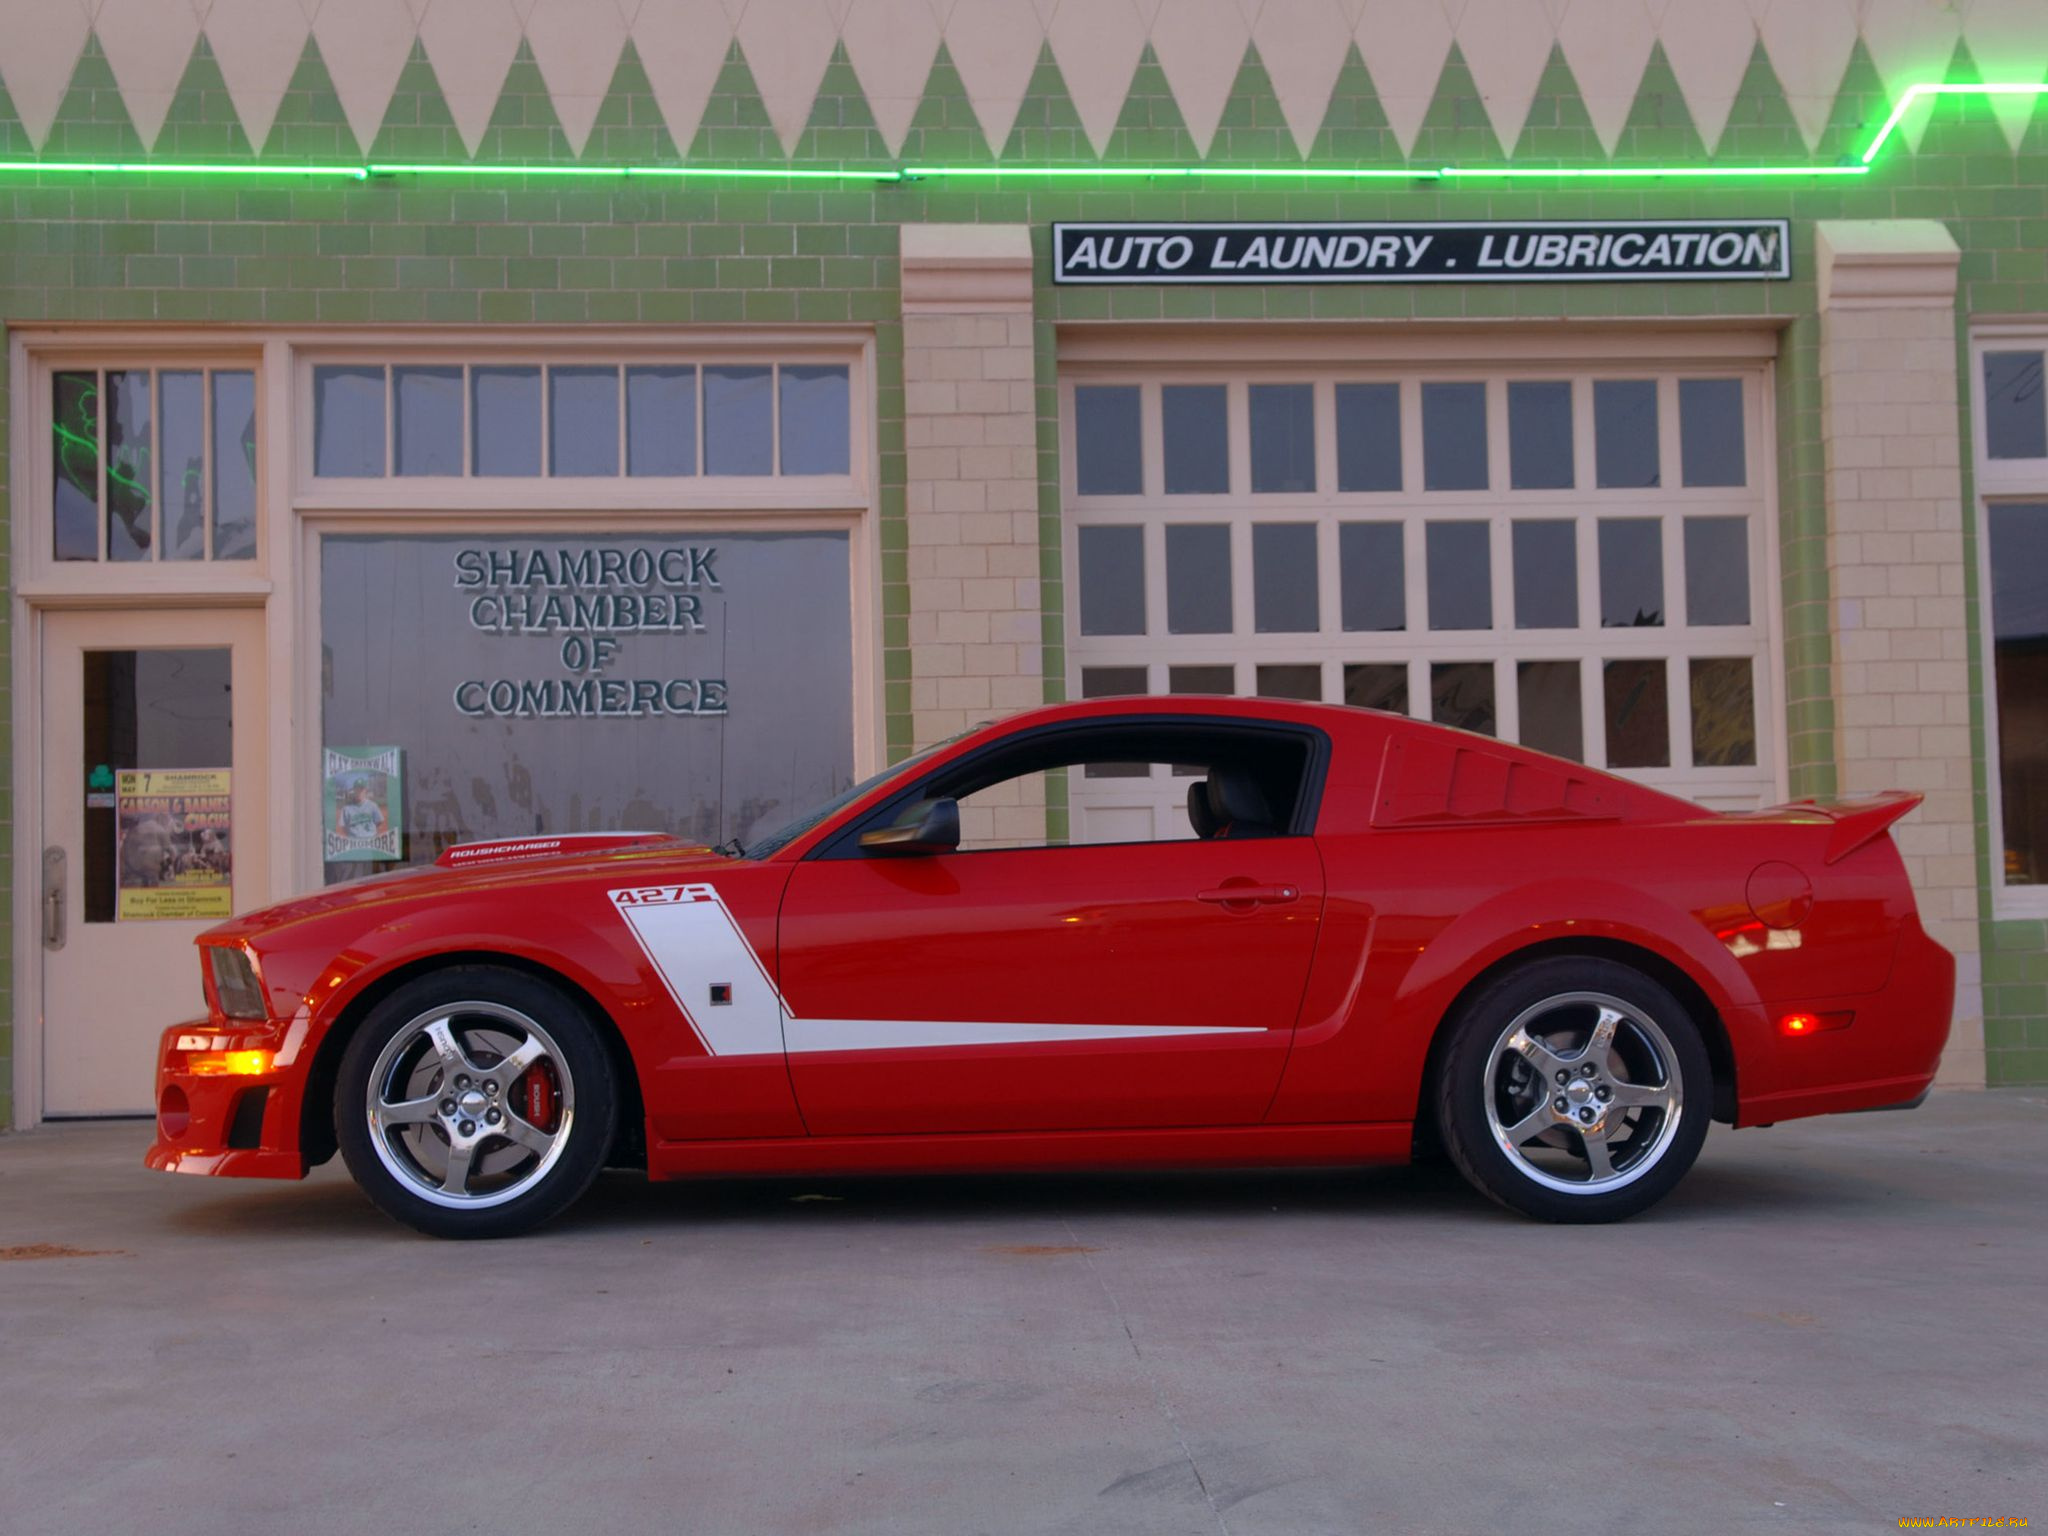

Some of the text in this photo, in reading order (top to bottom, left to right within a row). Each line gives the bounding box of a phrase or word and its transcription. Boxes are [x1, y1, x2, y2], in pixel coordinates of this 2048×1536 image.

[1065, 236, 1193, 270] AUTO
[1210, 235, 1433, 270] LAUNDRY
[1477, 232, 1778, 268] LUBRICATION
[453, 547, 721, 589] SHAMROCK
[469, 594, 706, 632] CHAMBER
[560, 635, 617, 673] OF
[453, 679, 728, 717] COMMERCE
[143, 774, 152, 793] 7
[328, 831, 395, 855] SOPHOMORE
[450, 840, 561, 859] ROUSHCHARGED
